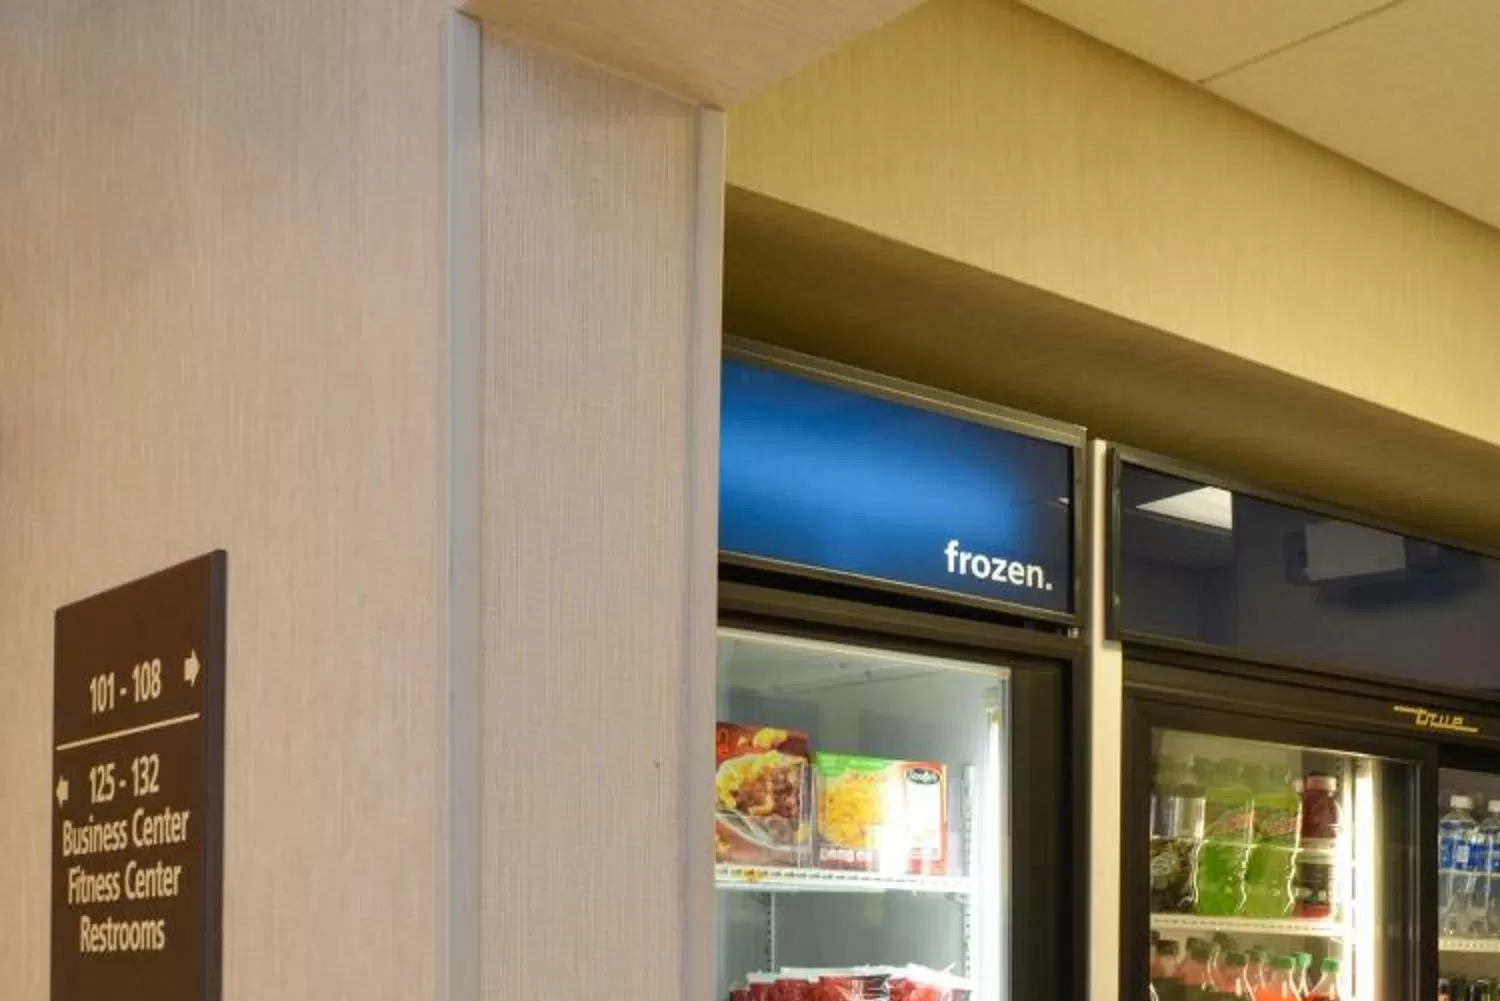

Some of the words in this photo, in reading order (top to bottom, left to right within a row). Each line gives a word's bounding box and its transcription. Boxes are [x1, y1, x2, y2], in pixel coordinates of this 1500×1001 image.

[943, 539, 1054, 592] frozen.
[89, 671, 116, 715] 101
[131, 657, 162, 703] 108
[88, 761, 116, 804] 125
[131, 752, 161, 797] 132
[62, 811, 129, 858] Business
[131, 805, 192, 848] Center
[67, 864, 122, 906] Fitness
[124, 859, 183, 900] Center
[79, 914, 167, 954] Restrooms
